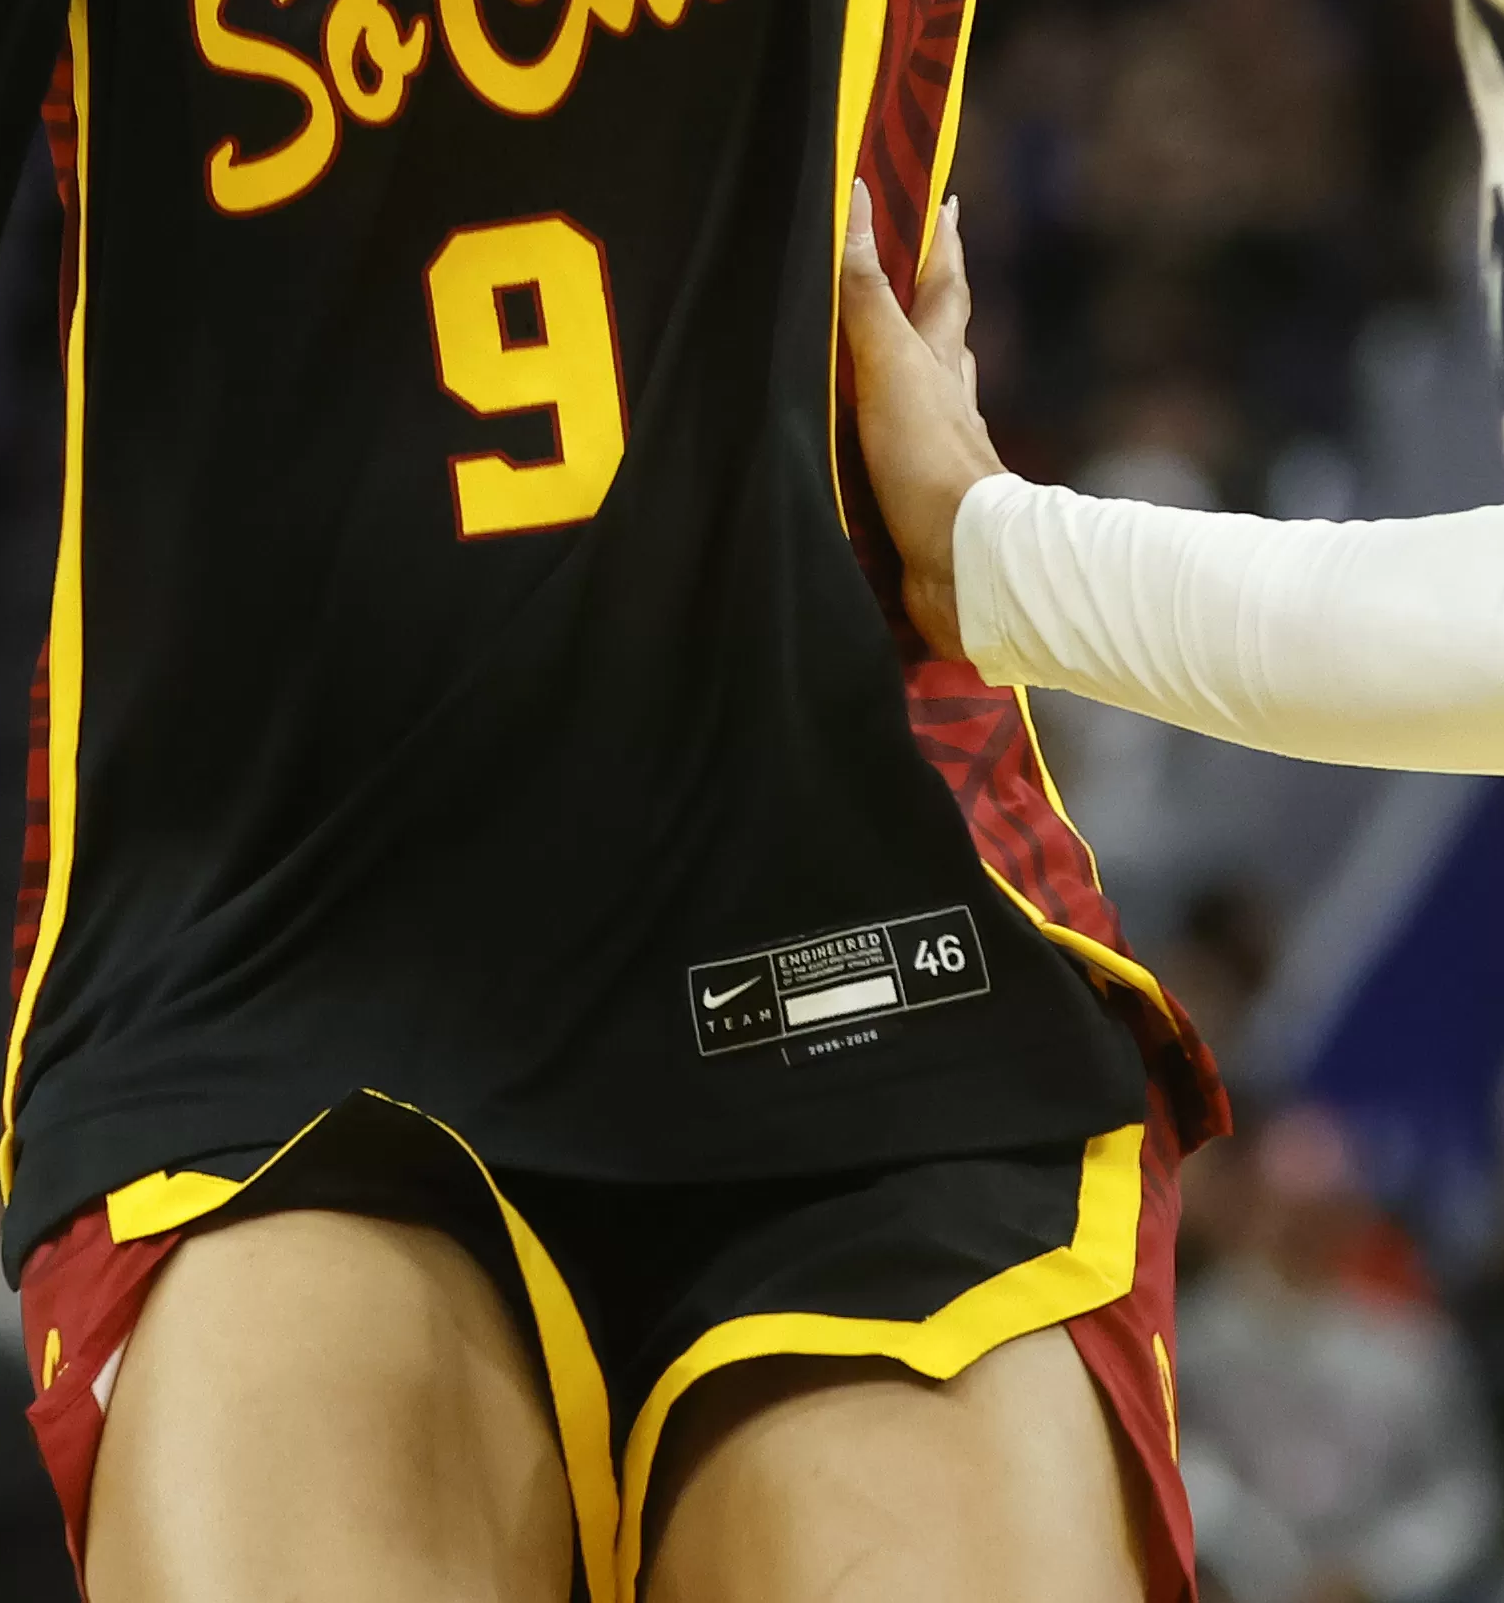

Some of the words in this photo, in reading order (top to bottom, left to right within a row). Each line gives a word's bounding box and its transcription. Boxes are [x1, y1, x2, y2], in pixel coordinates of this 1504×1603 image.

[422, 211, 630, 542] 9
[778, 932, 881, 969] ENGINEERED
[913, 933, 967, 978] 46
[704, 1007, 773, 1035] TEAM
